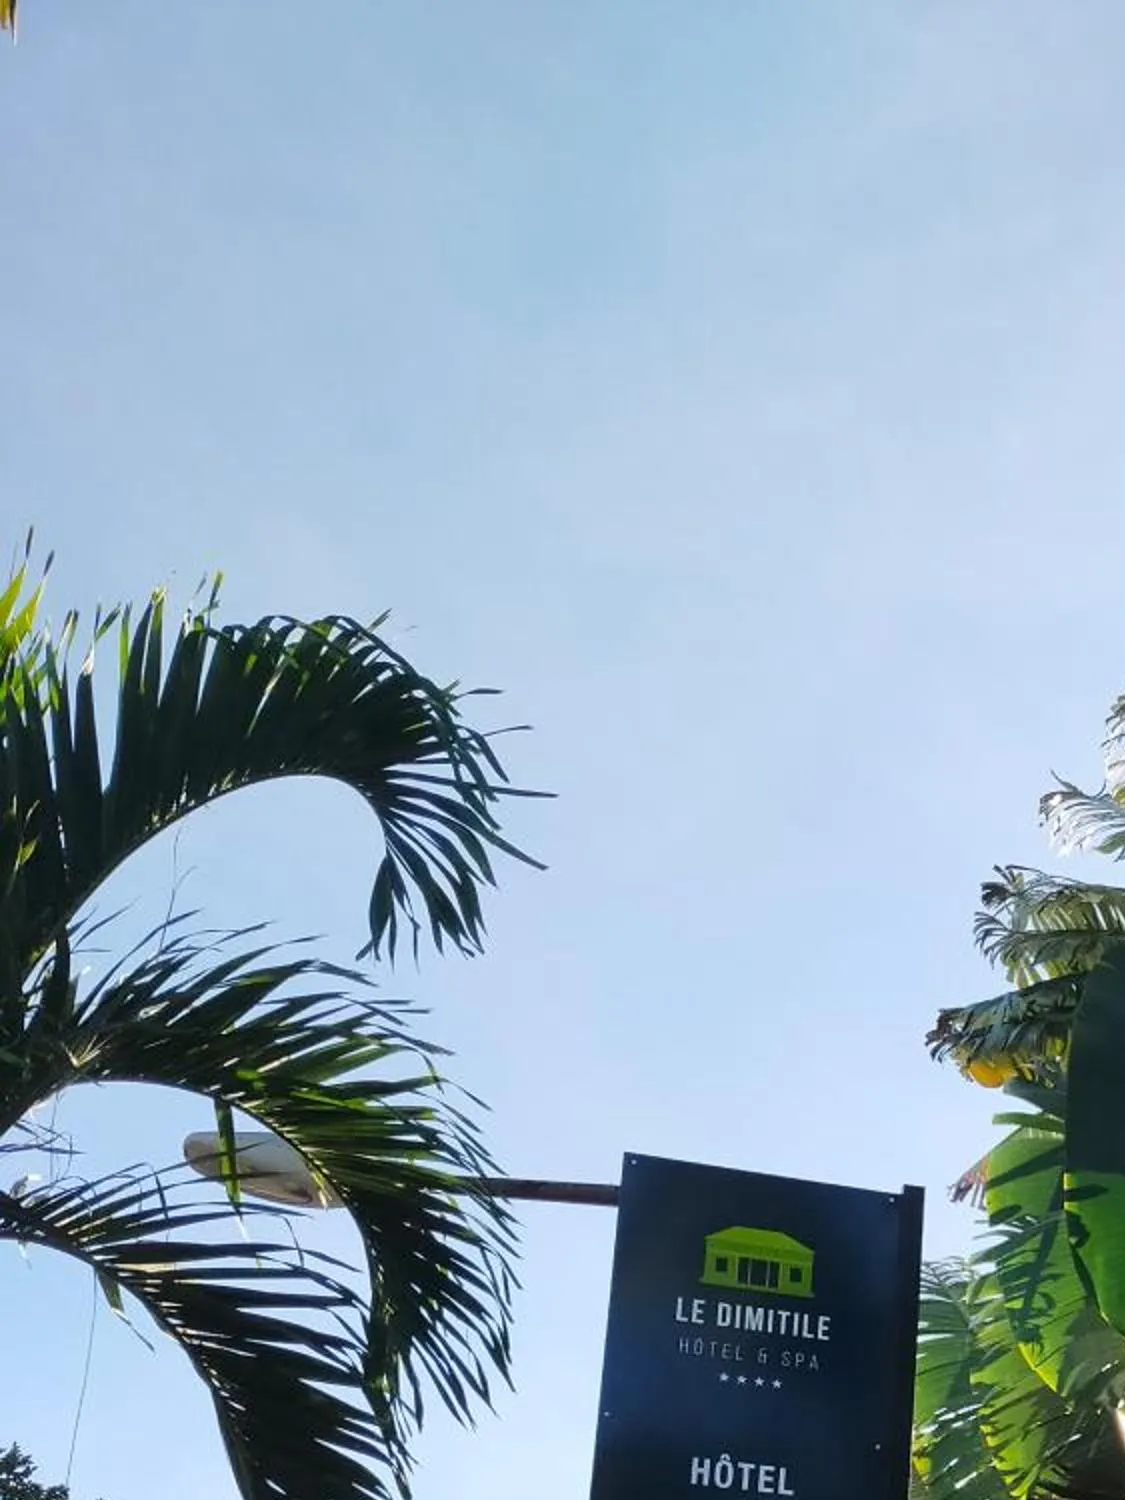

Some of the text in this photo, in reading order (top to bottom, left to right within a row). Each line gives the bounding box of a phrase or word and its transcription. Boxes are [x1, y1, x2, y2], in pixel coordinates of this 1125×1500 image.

[675, 1296, 832, 1341] LE DIMITILE
[757, 1346, 769, 1365] &
[781, 1350, 820, 1372] SPA
[690, 1454, 794, 1496] HÔTEL
